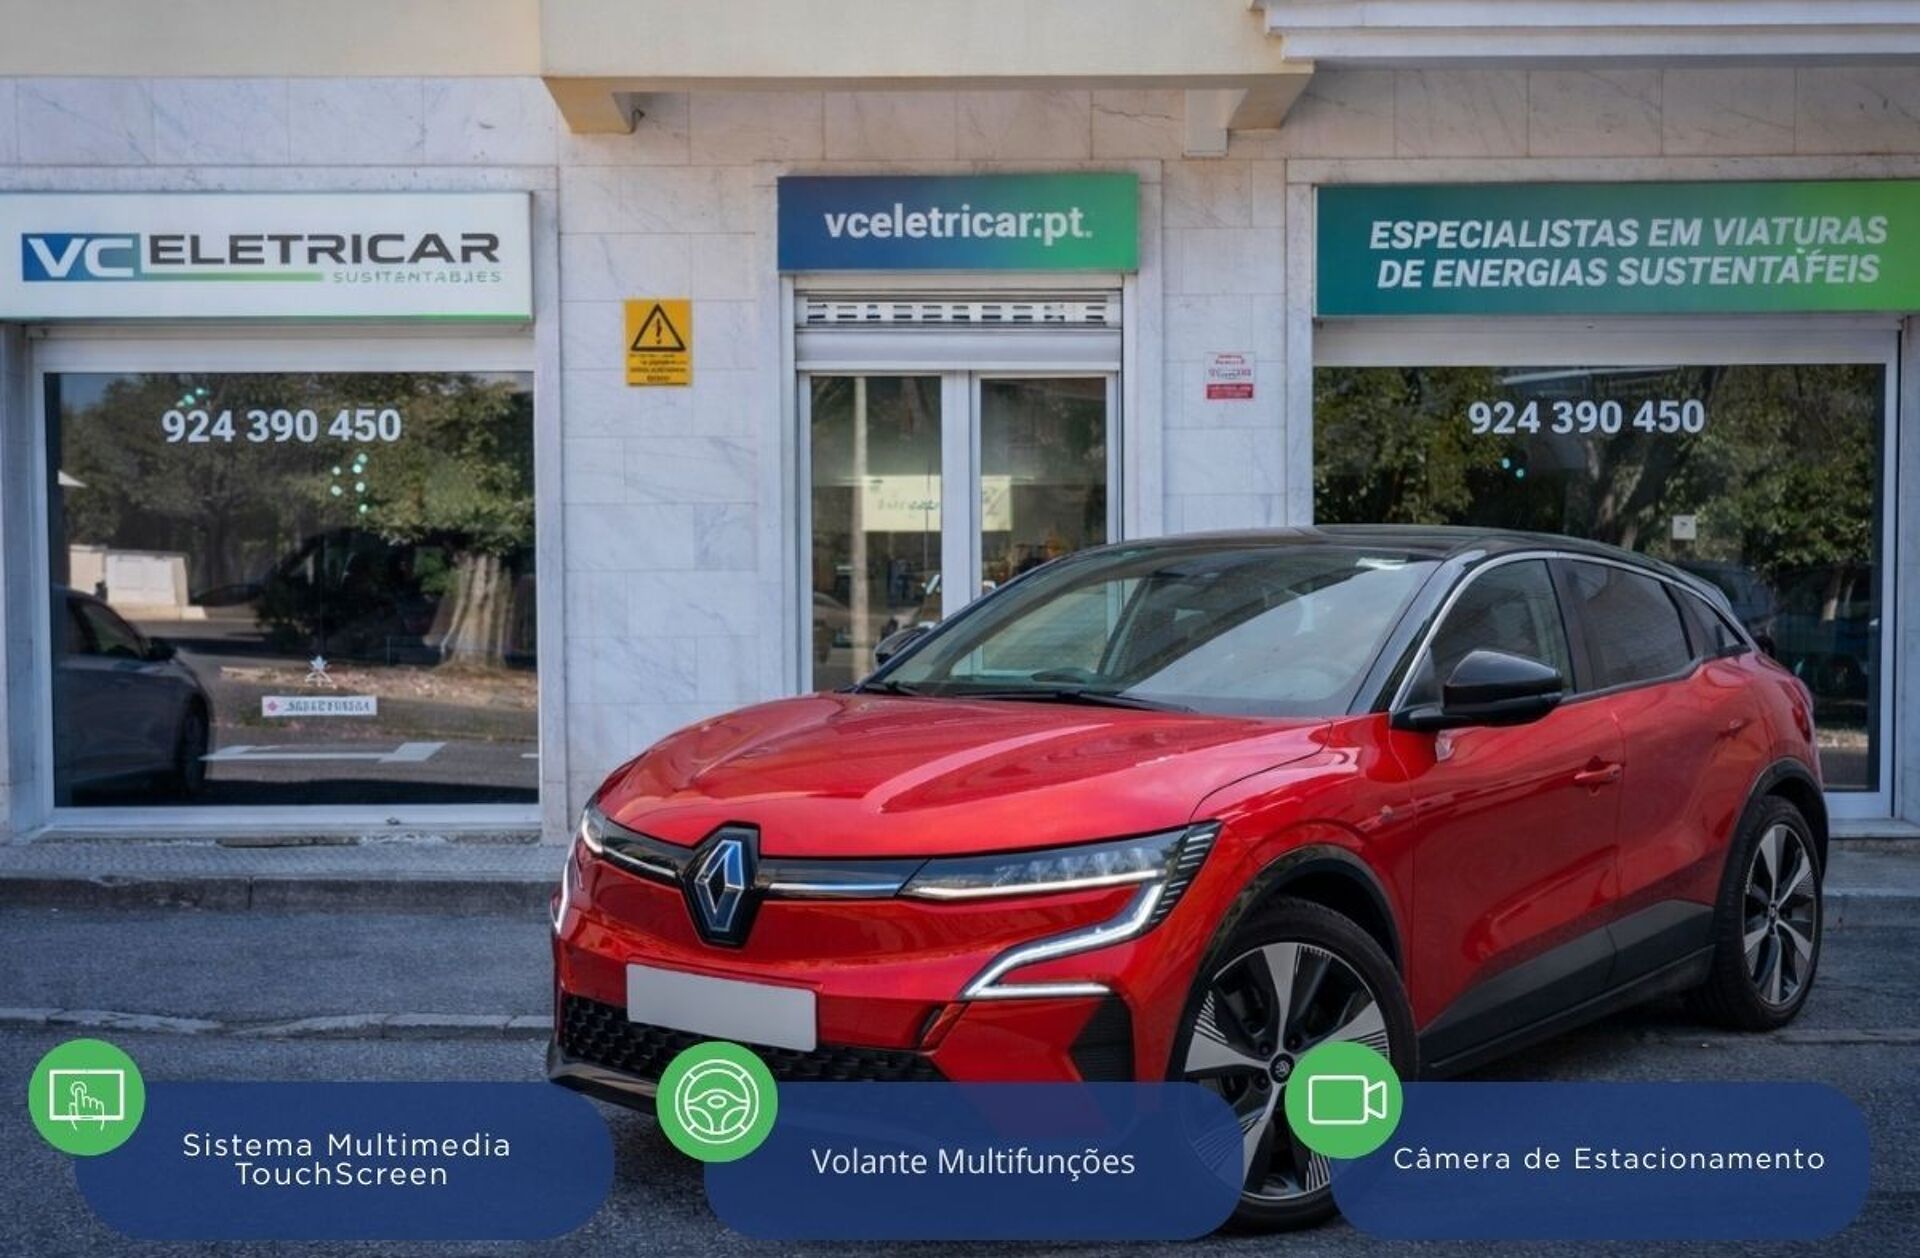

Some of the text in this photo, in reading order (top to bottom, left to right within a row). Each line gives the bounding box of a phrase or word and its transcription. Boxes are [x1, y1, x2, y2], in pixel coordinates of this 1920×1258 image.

[1369, 215, 1888, 250] ESPECIALISTAS EM VIATURAS
[27, 232, 500, 278] VC ELETRICAR
[1377, 259, 1425, 289] DE
[1432, 256, 1609, 288] ENERGIAS
[161, 407, 402, 443] 924 390 450
[1468, 399, 1705, 435] 924 390 450
